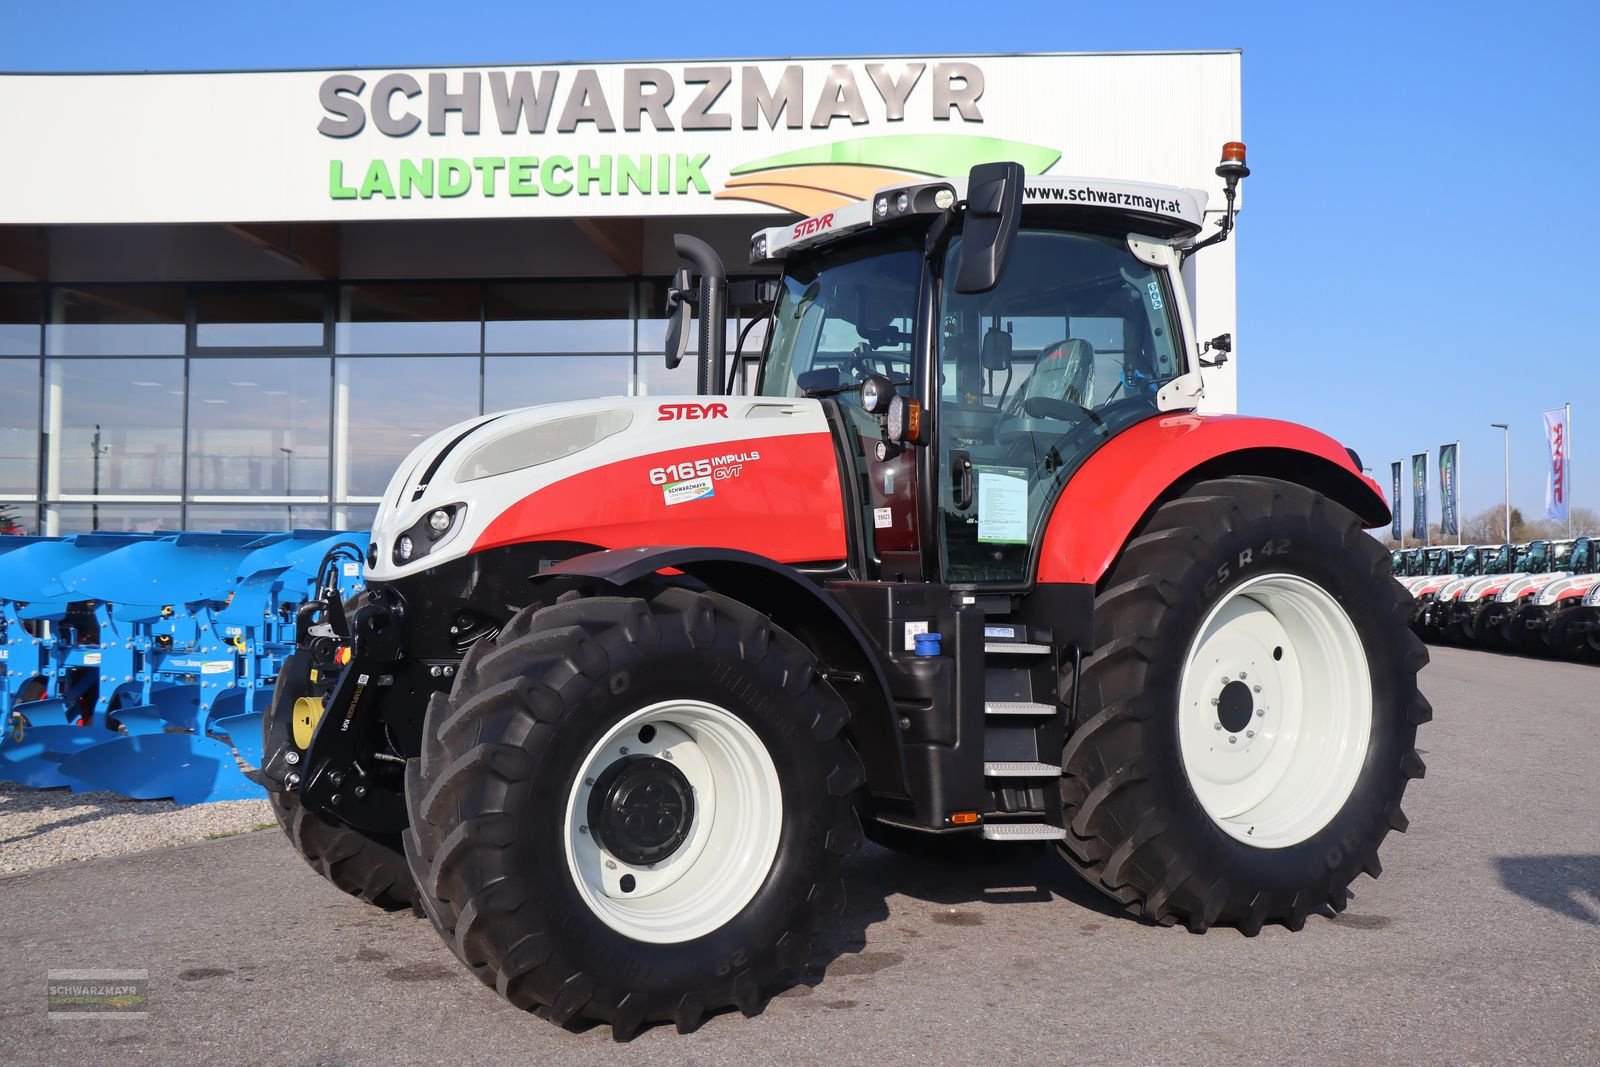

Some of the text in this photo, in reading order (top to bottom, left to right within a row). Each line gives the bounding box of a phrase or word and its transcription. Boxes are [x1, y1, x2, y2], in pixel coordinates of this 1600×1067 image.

[317, 62, 985, 138] SCHWARZMAYR
[328, 152, 712, 199] LANDTECHNIK
[1024, 186, 1182, 214] www.schwarzmayr.at
[792, 212, 834, 240] STEYR
[657, 403, 729, 421] STEYR
[649, 451, 760, 486] 6165 IMPULS
[713, 464, 743, 480] CVT
[668, 482, 706, 494] SCHWARZMAYR
[1239, 547, 1253, 568] R
[1261, 539, 1292, 556] 42
